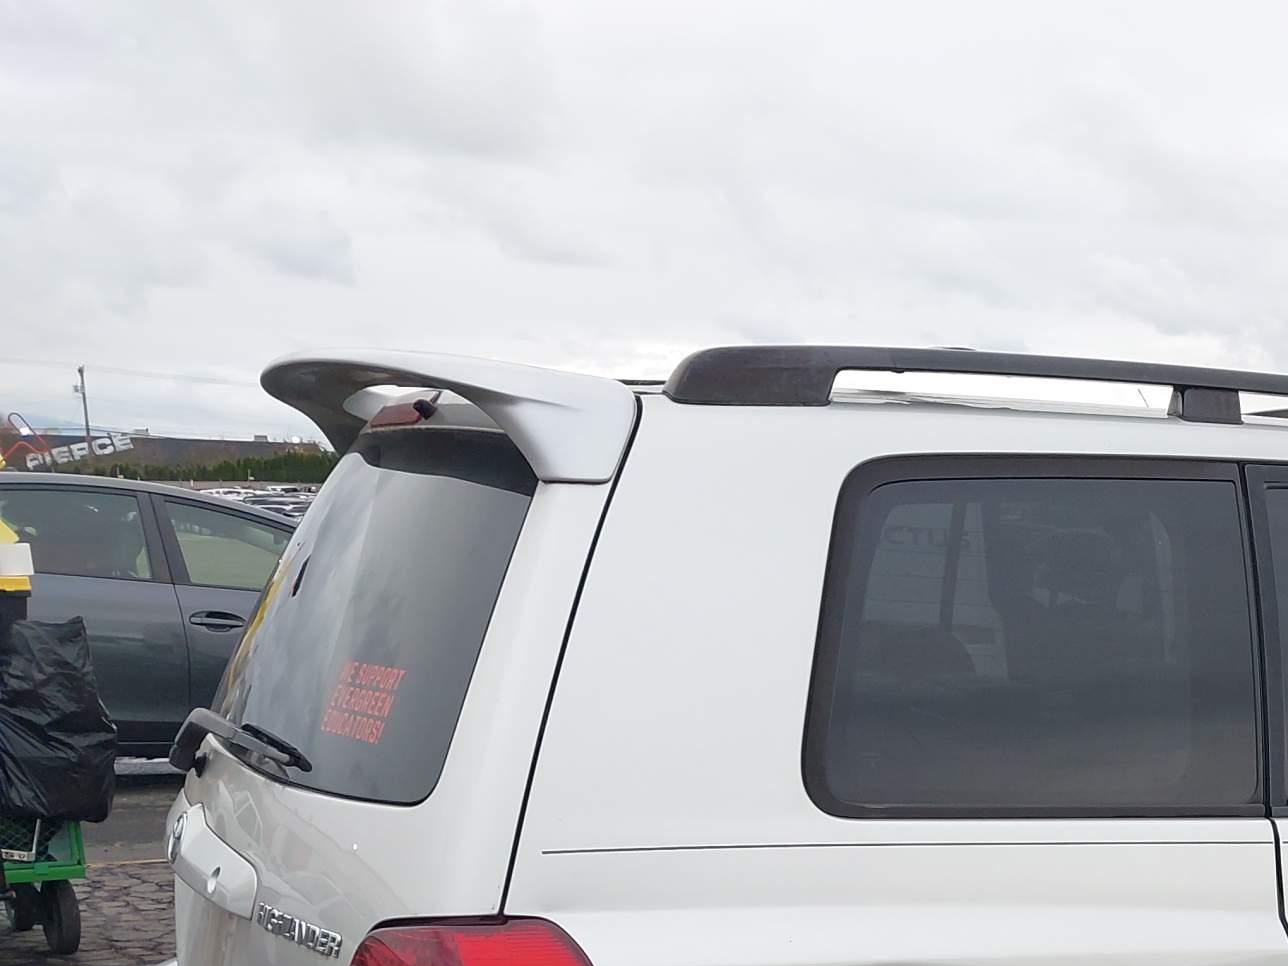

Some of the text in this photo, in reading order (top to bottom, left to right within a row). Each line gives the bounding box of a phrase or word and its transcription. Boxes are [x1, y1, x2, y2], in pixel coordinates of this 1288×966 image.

[25, 432, 134, 470] PIERCE
[359, 663, 406, 689] SUPPORT
[329, 684, 395, 718] EVERGREEN
[257, 902, 342, 959] HIGHLANDER
